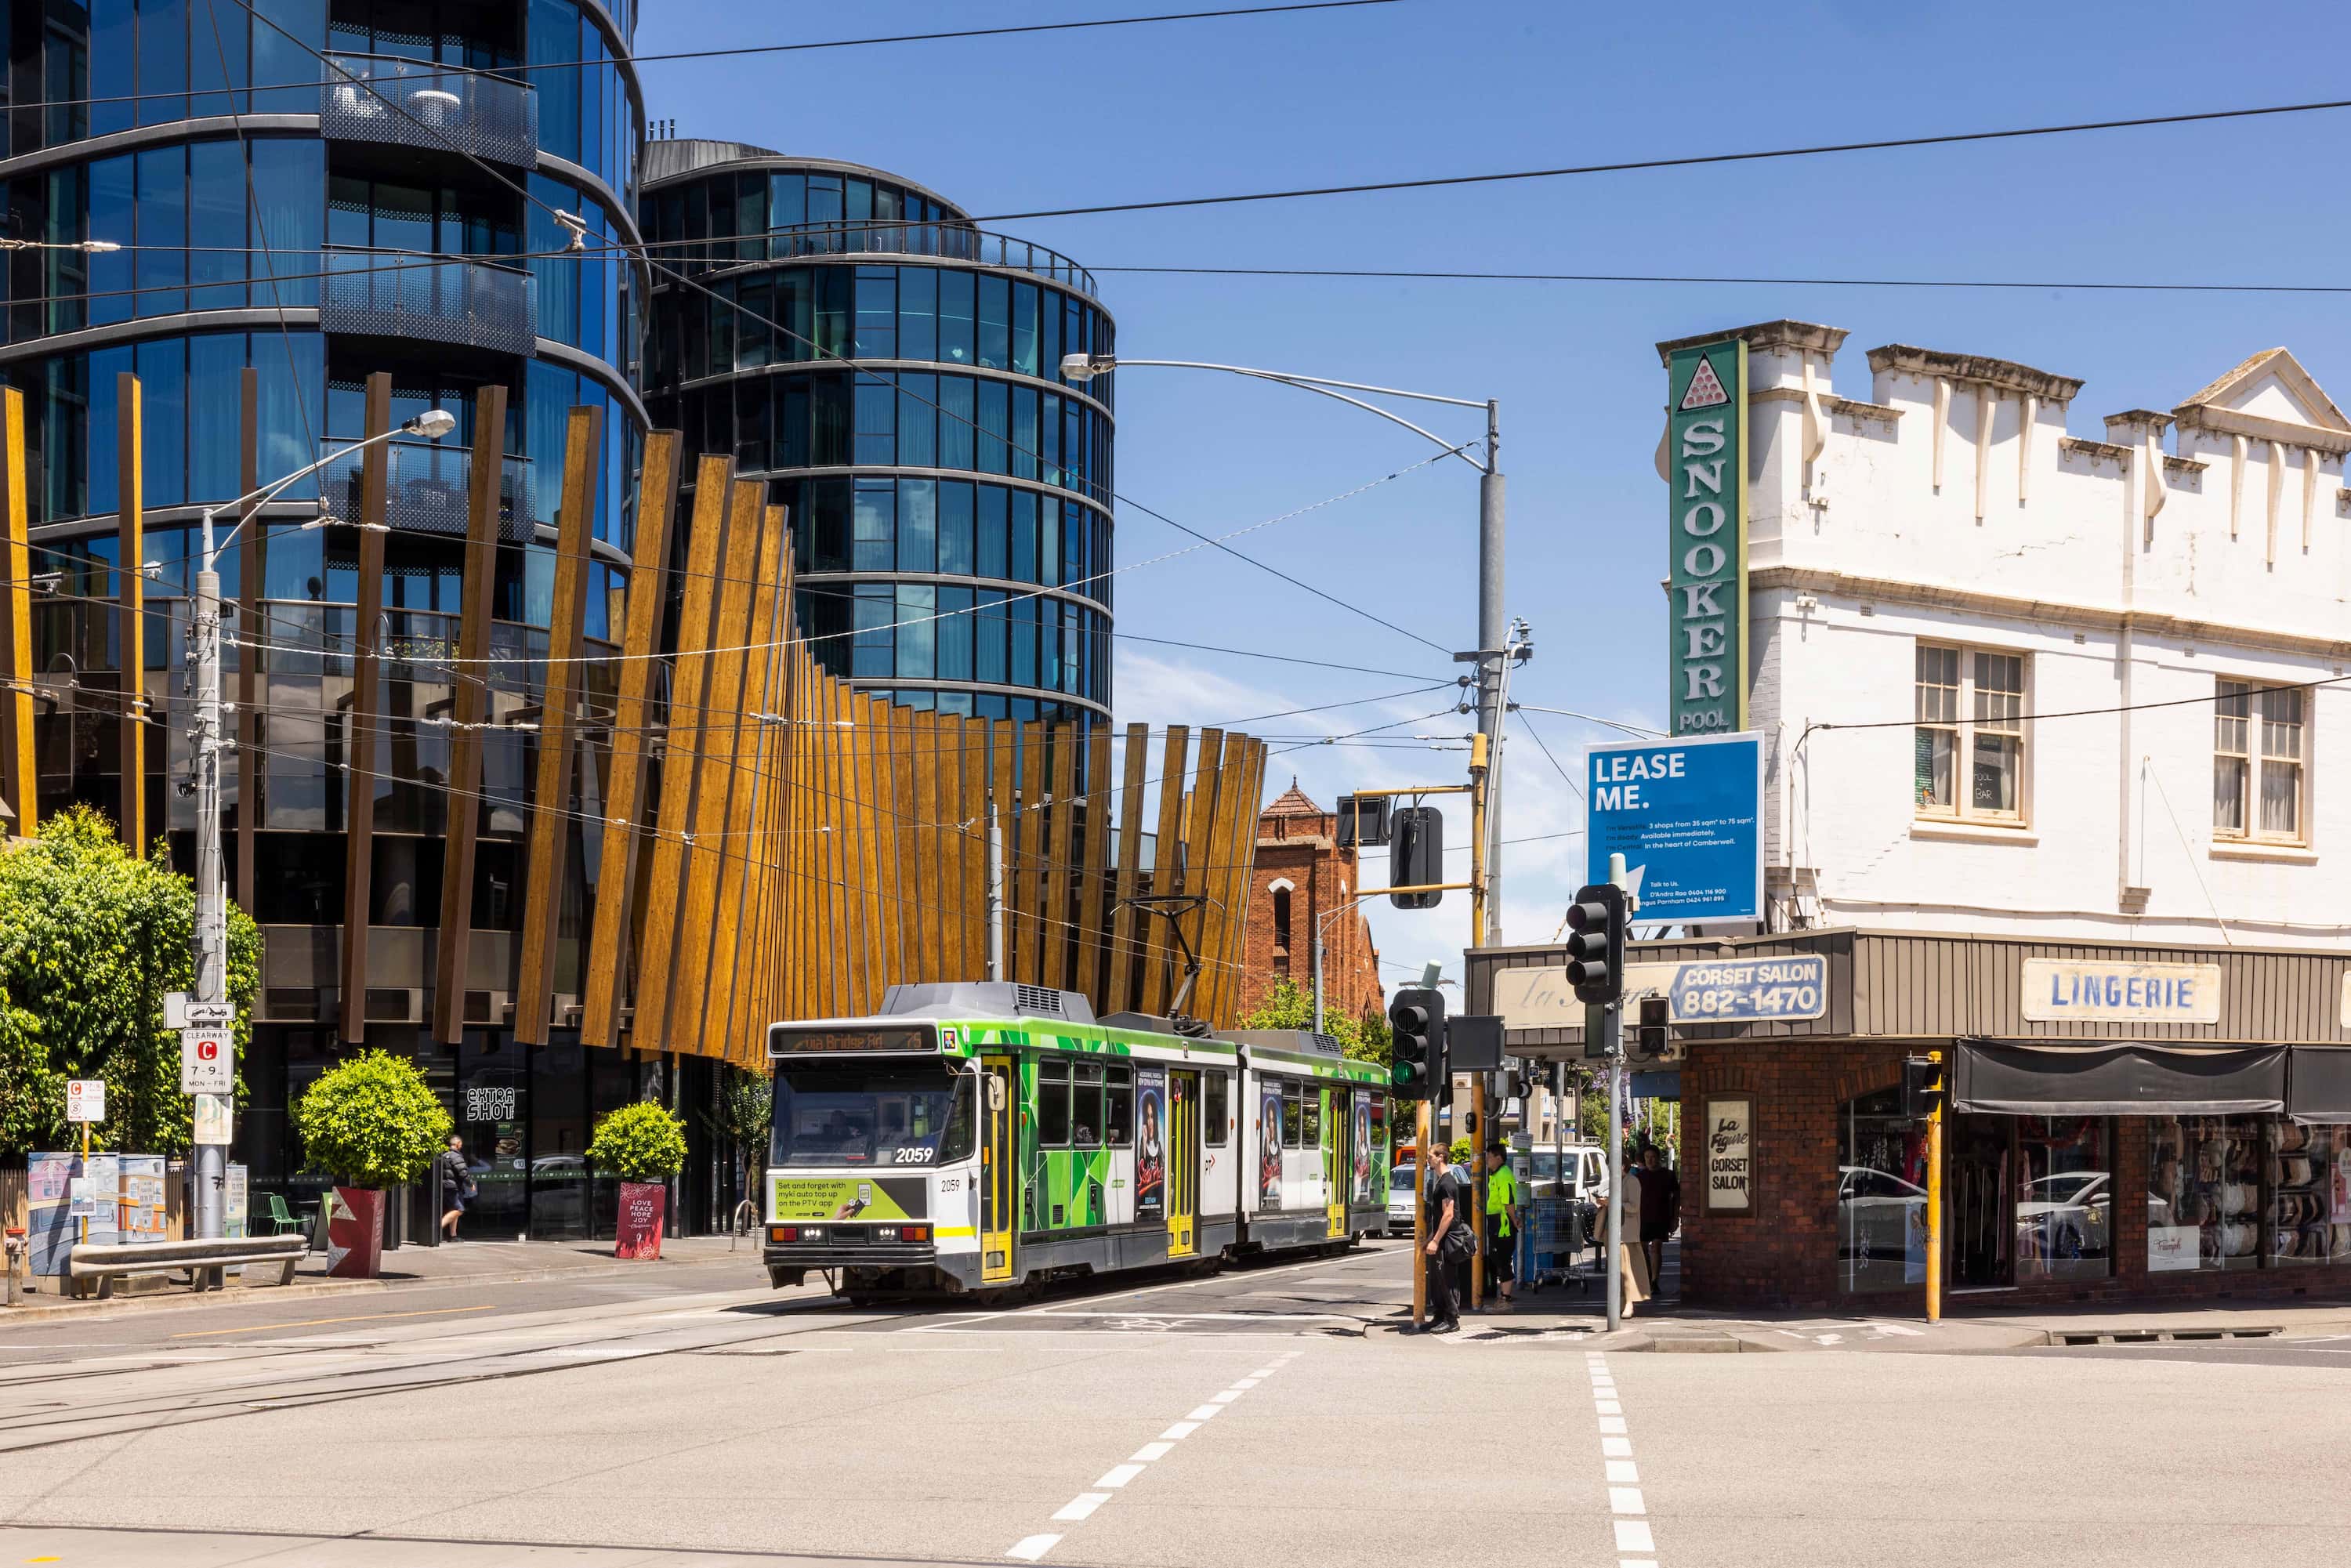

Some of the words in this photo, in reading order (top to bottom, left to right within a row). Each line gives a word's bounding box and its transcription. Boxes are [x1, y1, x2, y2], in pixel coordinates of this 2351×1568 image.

[1683, 419, 1726, 701] SNOOKER
[1679, 708, 1730, 730] POOL
[1596, 752, 1686, 783] LEASE
[1595, 784, 1650, 812] ME.
[1975, 788, 1993, 800] BAR
[1640, 831, 1672, 840] Available
[1672, 829, 1716, 838] immediately.
[1692, 838, 1737, 847] Camberwell.
[1685, 966, 1755, 987] CORSET
[1757, 963, 1817, 983] SALON
[2052, 973, 2193, 1009] LINGERIE
[1684, 986, 1817, 1015] 882-1470
[825, 1032, 864, 1050] Bridge
[866, 1031, 884, 1049] Rd
[202, 1042, 212, 1059] C
[467, 1103, 515, 1121] SHOT
[1718, 1118, 1740, 1133] La
[1710, 1133, 1748, 1153] Figure
[895, 1147, 934, 1163] 2059
[1712, 1157, 1748, 1172] CORSET
[807, 1182, 829, 1190] forget
[941, 1179, 960, 1192] 2059
[1712, 1175, 1746, 1190] SALON
[778, 1190, 795, 1199] myki
